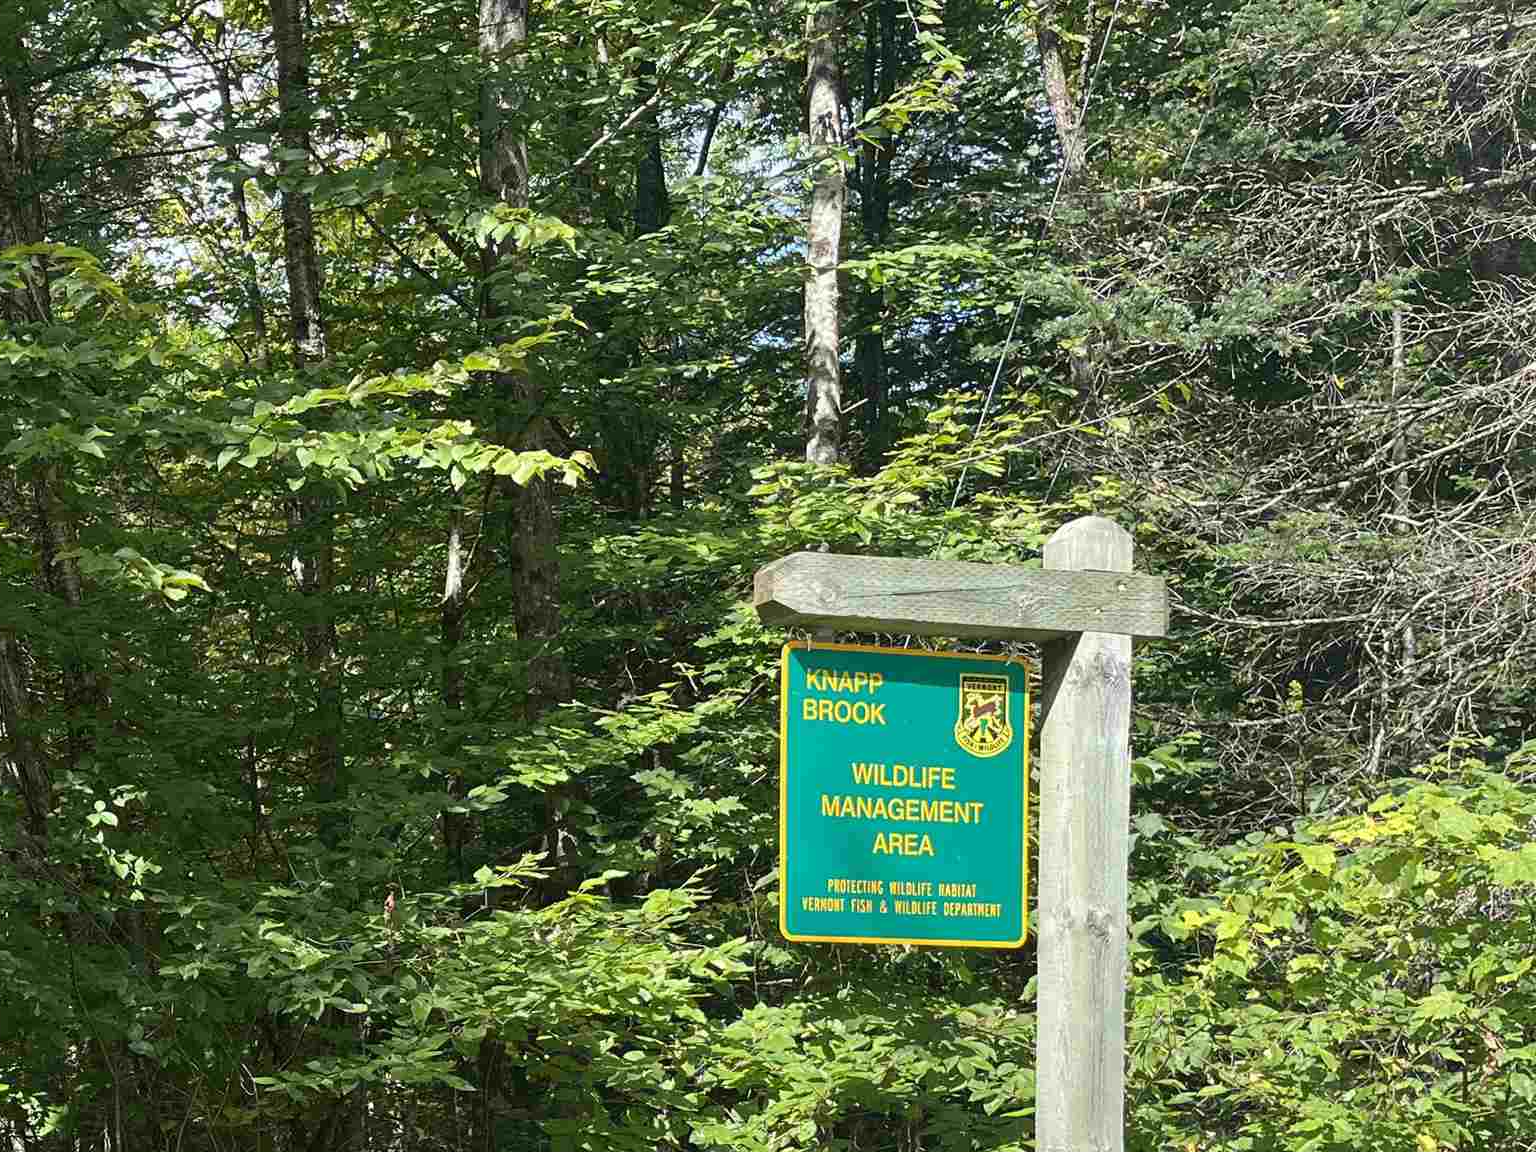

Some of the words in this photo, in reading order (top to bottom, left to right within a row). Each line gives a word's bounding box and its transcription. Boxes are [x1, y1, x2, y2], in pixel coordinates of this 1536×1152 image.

[807, 669, 883, 694] KNAPP
[803, 699, 887, 724] BROOK
[852, 762, 956, 789] WILDLIFE
[821, 794, 984, 824] MANAGEMENT
[872, 832, 934, 856] AREA
[826, 879, 884, 895] PROTECTING
[889, 881, 933, 896] WILDLIFE
[801, 896, 844, 912] VERMONT
[851, 898, 872, 912] FISH
[894, 900, 937, 915] WILDLIFE
[943, 902, 1002, 917] DEPARTMENT
